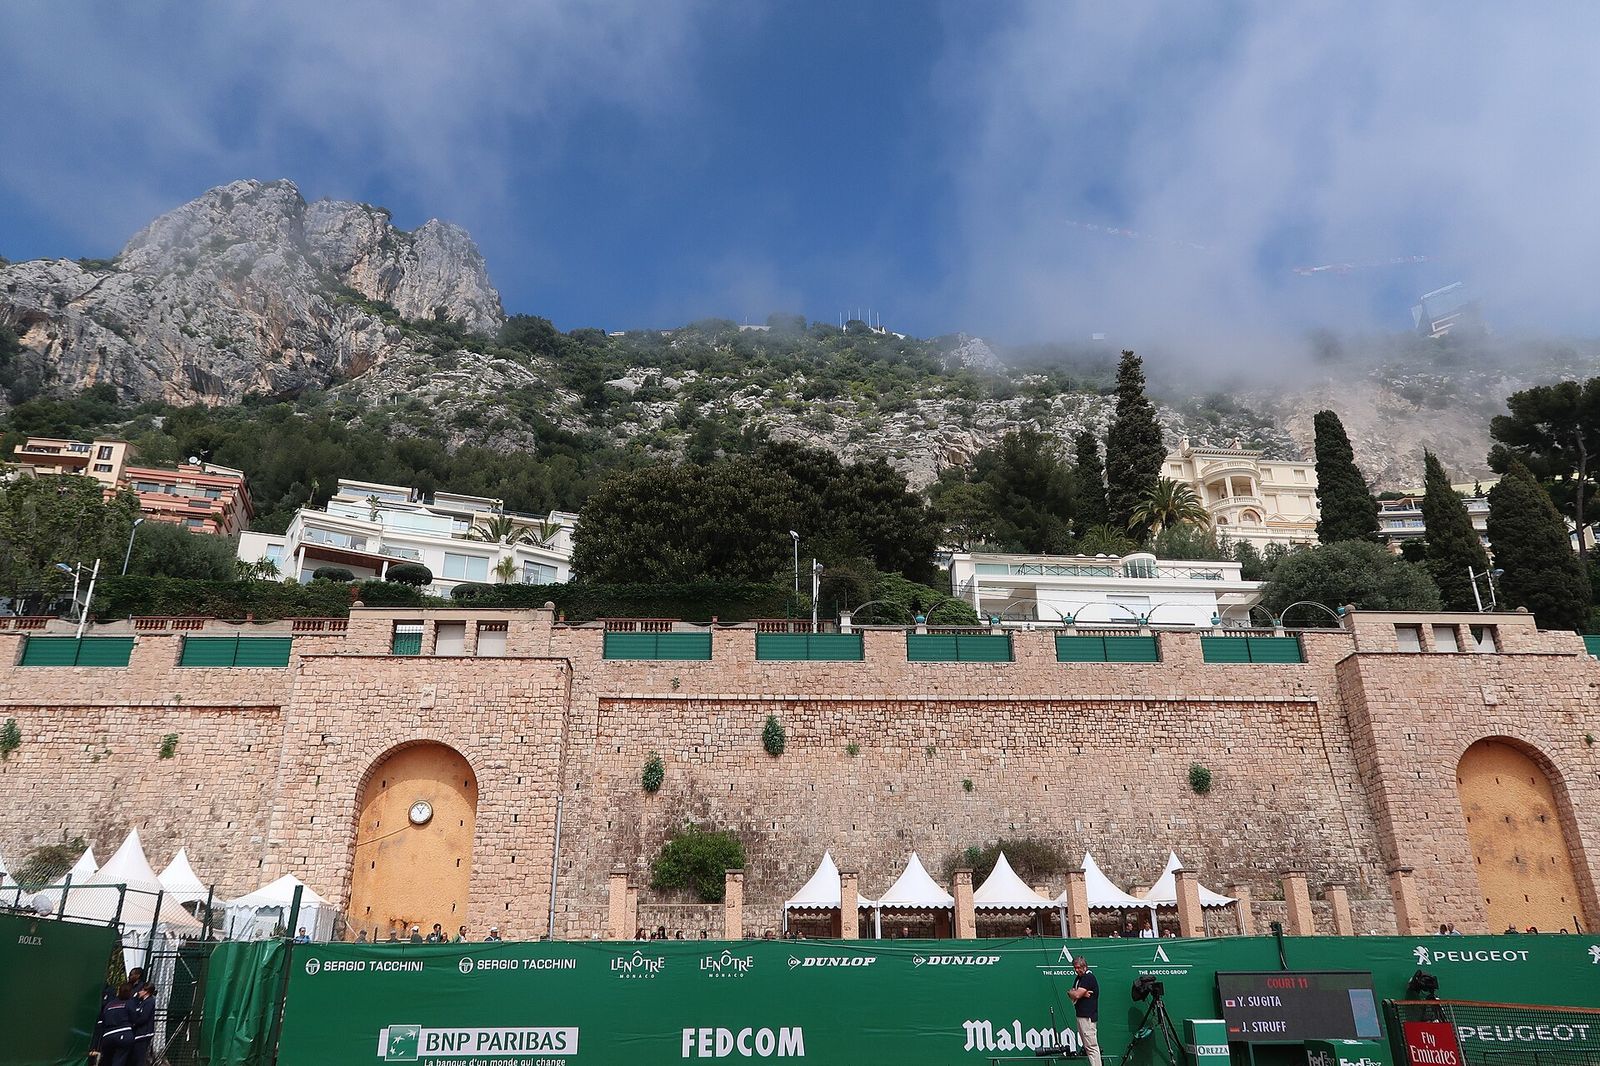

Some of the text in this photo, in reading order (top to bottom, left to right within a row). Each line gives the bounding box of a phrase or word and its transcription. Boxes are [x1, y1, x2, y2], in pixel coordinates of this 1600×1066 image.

[18, 935, 43, 946] ROLEX
[611, 950, 665, 972] LENÔTRE
[700, 949, 754, 972] LENÔTRE
[927, 956, 1000, 965] DUNLOP
[1434, 950, 1529, 962] PEUGEOT
[323, 961, 424, 971] SERGIO TACCHINI
[477, 959, 576, 970] SERGIO TACCHINI
[802, 957, 876, 967] DUNLOP
[1266, 977, 1309, 988] COURT 11
[1236, 996, 1282, 1007] Y. SUGITA
[1241, 1021, 1287, 1032] J. STRUFF
[1421, 1031, 1436, 1046] Fly
[1457, 1024, 1589, 1042] PEUGEOT
[425, 1031, 567, 1051] BNP PARIBAS
[682, 1027, 805, 1058] FEDCOM
[1410, 1045, 1457, 1066] Emirates
[424, 1058, 434, 1066] La
[469, 1058, 487, 1066] d'un
[490, 1058, 518, 1066] monde
[536, 1057, 566, 1066] change
